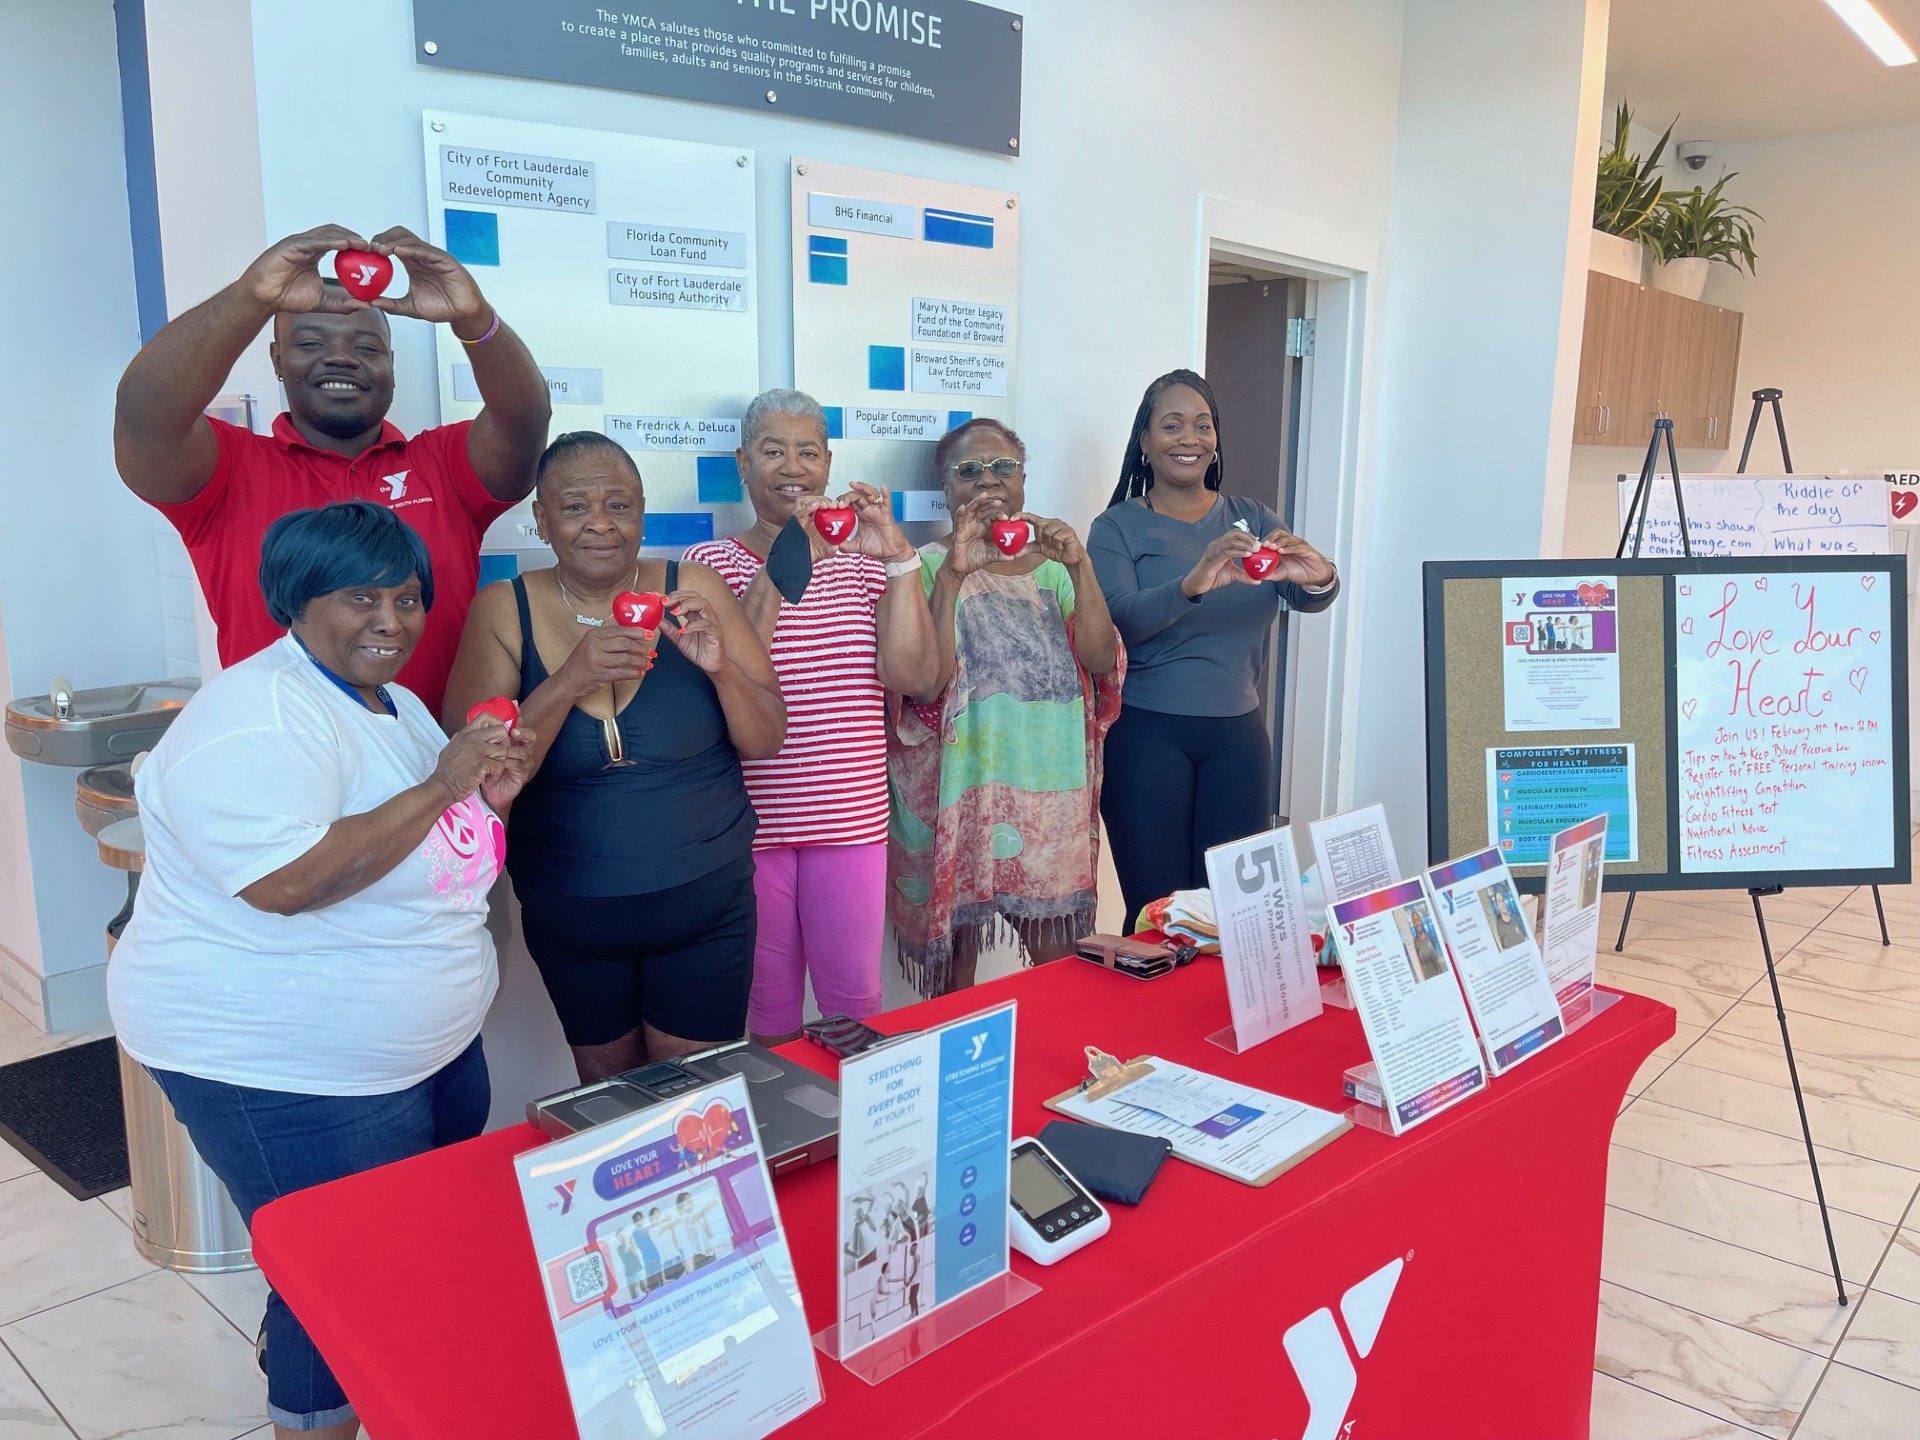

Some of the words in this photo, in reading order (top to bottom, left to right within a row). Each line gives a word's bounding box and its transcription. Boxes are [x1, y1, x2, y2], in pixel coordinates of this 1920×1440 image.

[811, 0, 942, 49] PROMISE
[596, 8, 618, 24] The
[622, 13, 656, 29] YMCA
[660, 20, 700, 37] salutes
[703, 27, 734, 43] those
[737, 32, 759, 47] who
[762, 39, 814, 58] committed
[816, 49, 827, 61] to
[830, 51, 867, 71] fulfilling
[869, 62, 875, 71] a
[878, 63, 911, 79] promise
[562, 20, 574, 32] to
[579, 24, 616, 39] create
[620, 31, 627, 40] a
[631, 31, 661, 46] place
[665, 36, 688, 50] that
[692, 41, 737, 58] provides
[741, 50, 775, 67] quality
[779, 56, 824, 74] programs
[827, 65, 844, 78] and
[847, 70, 883, 86] services
[885, 77, 897, 89] for
[900, 79, 935, 99] children,
[621, 43, 669, 64] families,
[672, 53, 706, 68] adults
[709, 57, 729, 71] and
[733, 62, 770, 78] seniors
[773, 68, 782, 79] in
[786, 70, 802, 83] the
[804, 75, 844, 92] Sistrunk
[846, 84, 895, 103] community.
[447, 150, 472, 167] City
[476, 155, 489, 166] of
[494, 156, 519, 170] Fort
[524, 159, 589, 178] Lauderdale
[486, 170, 554, 191] Community
[449, 182, 543, 202] Redevelopment
[547, 193, 590, 208] Agency
[835, 205, 853, 219] BHG
[856, 209, 893, 224] Financial
[626, 229, 665, 243] Florida
[668, 233, 729, 250] Community
[650, 245, 676, 258] Loan
[680, 247, 707, 260] Fund
[616, 273, 638, 287] City
[642, 275, 653, 286] of
[657, 275, 680, 287] Fort
[683, 277, 742, 292] Lauderdale
[629, 288, 675, 304] Housing
[678, 291, 730, 306] Authority
[919, 301, 939, 314] Mary
[941, 304, 950, 314] N.
[952, 304, 976, 316] Porter
[978, 307, 1003, 321] Legacy
[917, 313, 936, 325] Fund
[938, 315, 948, 326] of
[949, 316, 962, 327] the
[964, 318, 1005, 333] Community
[918, 326, 961, 339] Foundation
[963, 330, 972, 340] of
[973, 331, 1004, 343] Broward
[915, 352, 947, 365] Broward
[949, 355, 981, 367] Sheriff's
[983, 357, 1005, 368] Office
[928, 366, 944, 376] Law
[946, 367, 992, 379] Enforcement
[940, 378, 961, 390] Trust
[963, 379, 981, 390] Fund
[612, 419, 632, 431] The
[636, 419, 680, 432] Fredrick
[684, 421, 695, 432] A.
[698, 422, 736, 433] DeLuca
[856, 410, 889, 424] Popular
[891, 411, 937, 425] Community
[644, 433, 706, 445] Foundation
[870, 423, 901, 437] Capital
[903, 424, 924, 436] Fund
[1889, 474, 1920, 485] AED
[1781, 482, 1834, 500] Riddle
[1807, 503, 1842, 524] day
[1687, 517, 1711, 530] has
[1716, 519, 1755, 533] shown
[1731, 540, 1752, 548] can
[1821, 540, 1858, 552] was
[1706, 582, 1780, 658] Love
[1791, 582, 1863, 654] Your
[1728, 658, 1825, 718] Heart
[1714, 726, 1739, 745] Join
[1771, 724, 1810, 740] February
[1867, 720, 1878, 731] PM
[1499, 749, 1565, 758] COMPONENTS
[1566, 748, 1581, 756] OF
[1584, 747, 1624, 755] FITNESS
[1685, 750, 1706, 767] Tips
[1710, 754, 1720, 762] on
[1723, 748, 1737, 760] how
[1750, 746, 1769, 761] Keep
[1773, 743, 1798, 758] Blood
[1801, 742, 1833, 755] Pressure
[1516, 769, 1584, 777] CARDIORESPIRATORY
[1585, 767, 1623, 775] ENDURANCE
[1531, 760, 1549, 768] FOR
[1552, 759, 1588, 767] HEALTH
[1685, 766, 1723, 789] Register
[1779, 758, 1816, 774] Personal
[1686, 785, 1748, 807] Weightlifting
[1755, 778, 1807, 798] Competition
[1686, 805, 1718, 823] Cardio
[1721, 805, 1754, 818] Fitness
[1687, 822, 1736, 840] Nutritional
[1742, 822, 1769, 835] Advice
[1686, 845, 1723, 861] Fitness
[1729, 837, 1788, 859] Assessment
[1234, 845, 1280, 894] 5
[1263, 891, 1270, 907] To
[1272, 887, 1288, 942] Ways
[1266, 909, 1279, 951] Protect
[1273, 952, 1284, 980] Your
[1279, 983, 1289, 1020] Bones
[868, 1056, 922, 1086] STRETCHING
[886, 1078, 904, 1094] FOR
[867, 1094, 895, 1117] EVERY
[897, 1086, 922, 1104] BODY
[873, 1116, 884, 1129] AT
[884, 1108, 906, 1123] YOUR
[610, 1159, 633, 1176] LOVE
[633, 1149, 658, 1166] YOUR
[613, 1160, 662, 1190] HEART
[592, 1332, 615, 1350] LOVE
[614, 1321, 638, 1339] YOUR
[639, 1310, 664, 1327] HEART
[672, 1295, 694, 1311] START
[694, 1285, 712, 1300] THIS
[713, 1277, 730, 1292] NEW
